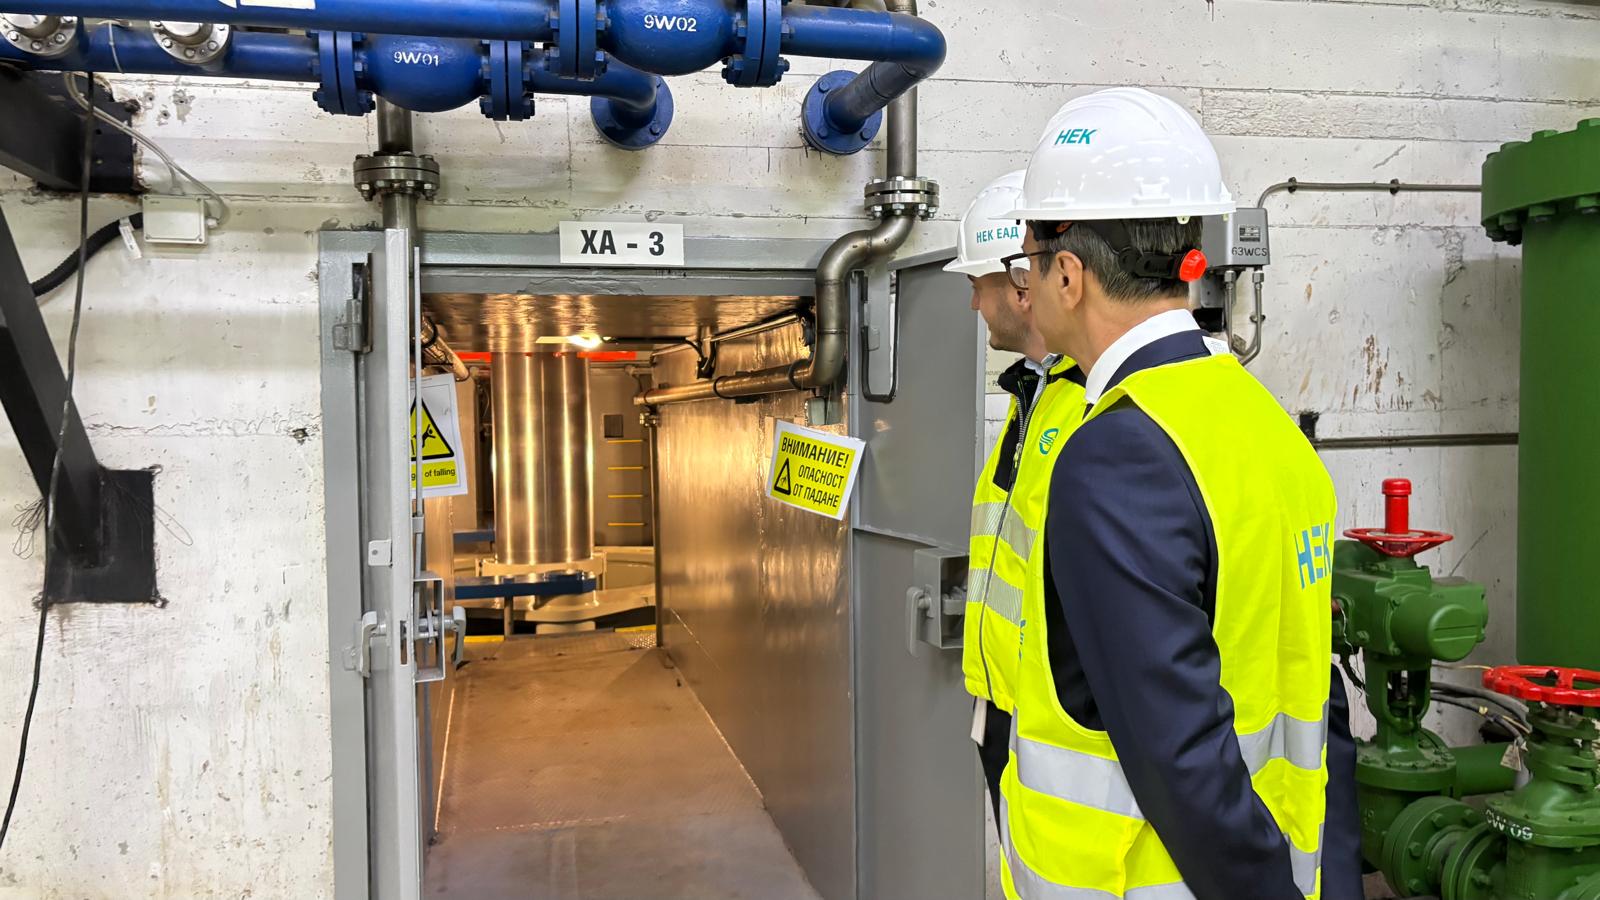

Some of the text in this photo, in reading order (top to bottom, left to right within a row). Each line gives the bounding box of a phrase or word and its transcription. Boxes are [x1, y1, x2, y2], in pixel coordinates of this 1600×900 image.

[643, 14, 697, 32] 9W02
[393, 51, 440, 66] 9W01
[1054, 128, 1097, 146] НЕК
[648, 231, 665, 256] 3
[976, 226, 1019, 243] НЕК ЕАД
[1231, 246, 1268, 256] 63WCS
[781, 437, 849, 468] ВНИМАНИЕ!
[424, 469, 432, 477] of
[433, 467, 455, 477] falling
[798, 464, 844, 489] ОПАСНОСТ
[792, 483, 840, 508] ОТ ПАДАНЕ
[1294, 522, 1331, 589] НЕК
